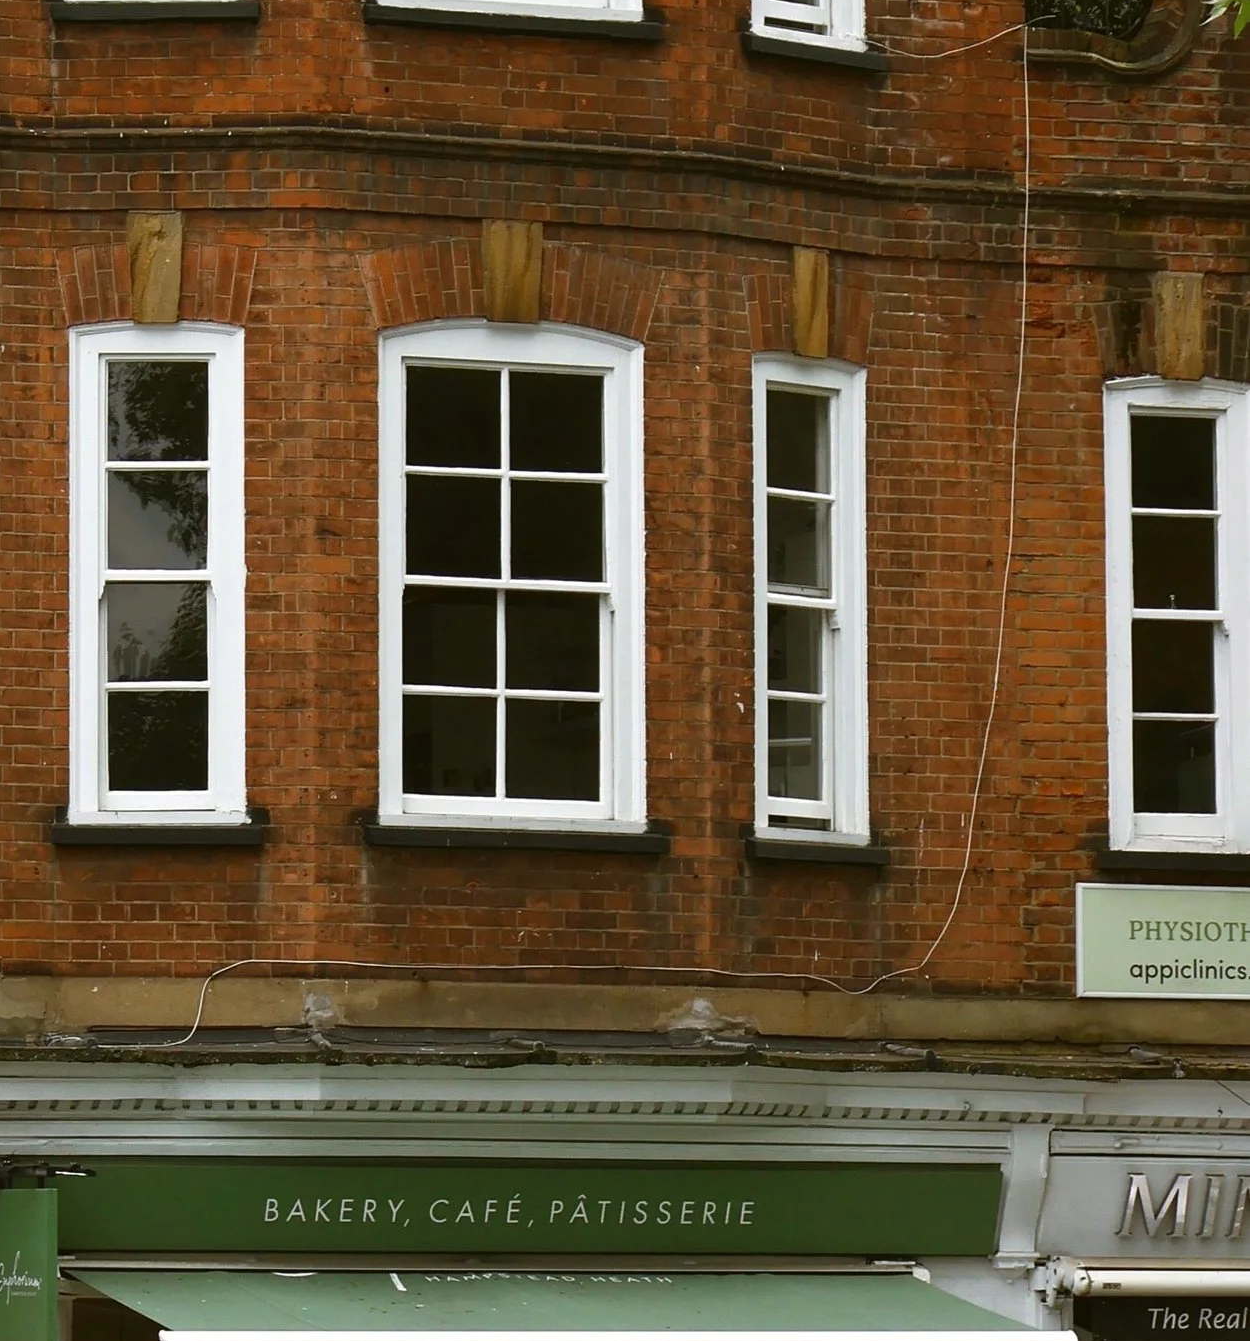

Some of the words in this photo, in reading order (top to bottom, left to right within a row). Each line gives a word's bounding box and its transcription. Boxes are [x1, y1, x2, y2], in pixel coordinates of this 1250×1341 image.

[263, 1197, 411, 1227] BAKERY,
[428, 1192, 534, 1228] CAFÉ,
[549, 1192, 755, 1225] PÂTISSERIE
[1148, 1306, 1190, 1330] The
[1198, 1306, 1249, 1330] Real
